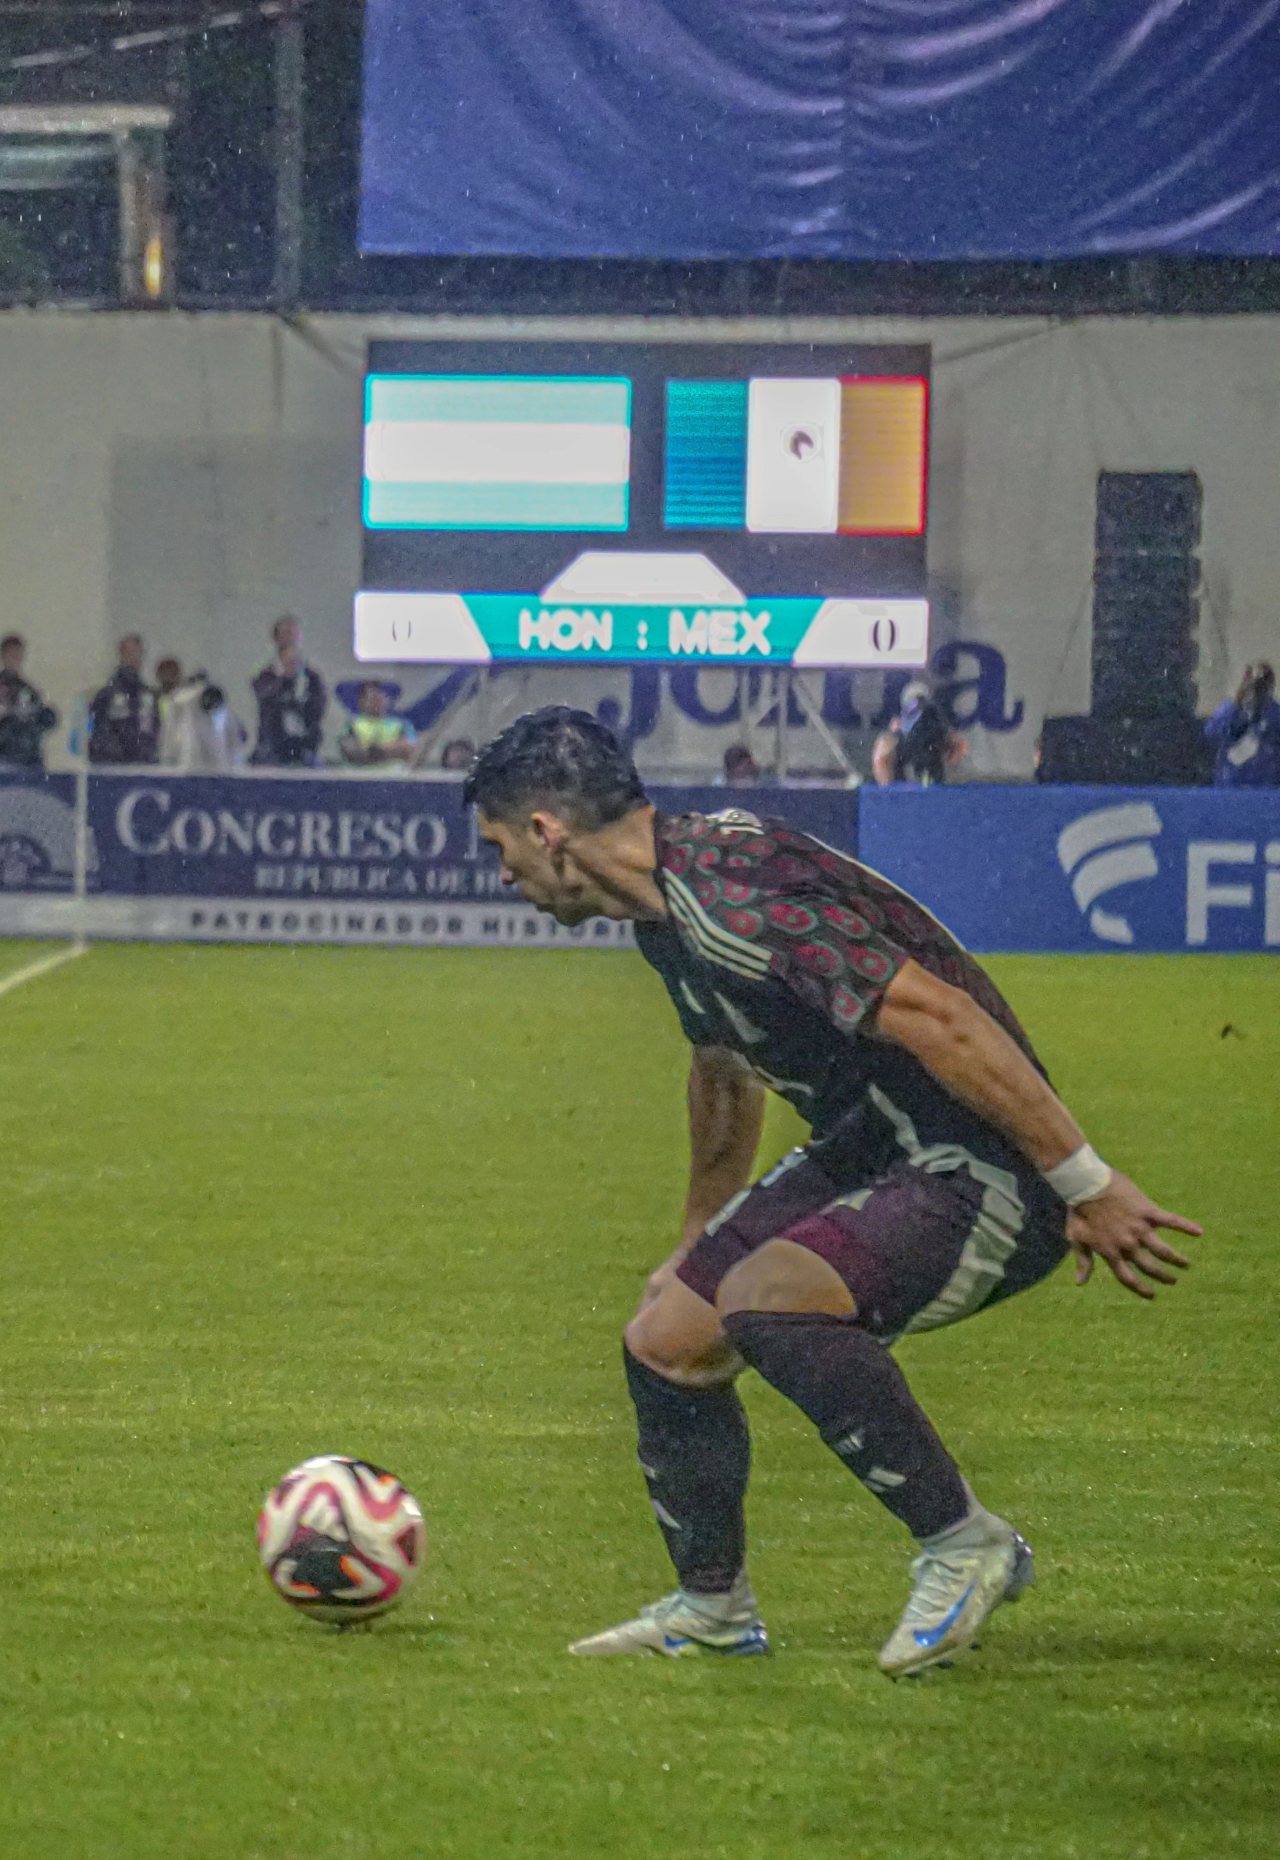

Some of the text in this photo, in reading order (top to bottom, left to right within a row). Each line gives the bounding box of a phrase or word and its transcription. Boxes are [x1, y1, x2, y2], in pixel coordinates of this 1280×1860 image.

[518, 607, 614, 651] HON
[669, 609, 771, 656] MEX
[871, 618, 897, 653] 0
[116, 787, 448, 859] CONGRESO
[190, 909, 465, 935] PATROCINADOR
